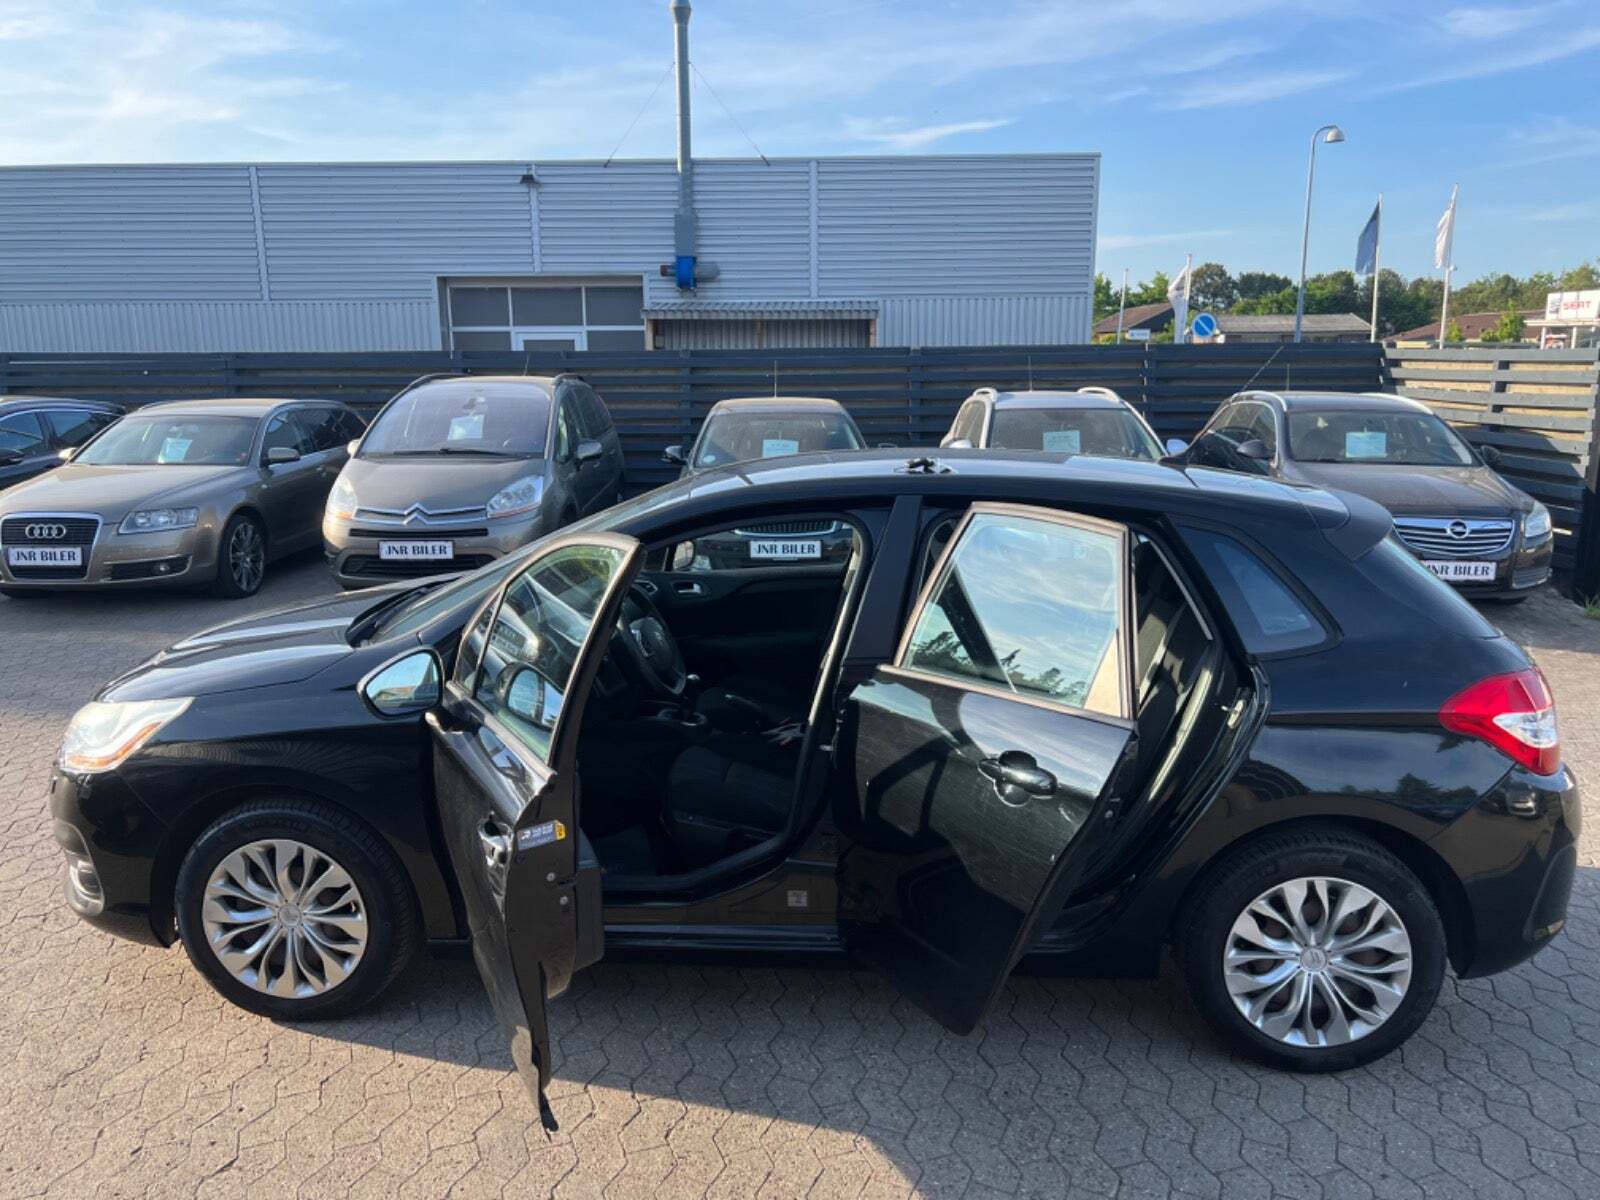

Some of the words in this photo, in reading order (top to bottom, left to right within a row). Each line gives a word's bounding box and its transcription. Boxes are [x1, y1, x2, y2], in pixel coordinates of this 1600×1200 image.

[386, 545, 408, 555] JNR
[412, 545, 447, 555] BILER
[754, 543, 777, 554] JNR
[781, 543, 816, 554] BILER
[16, 550, 37, 561] JNR
[40, 550, 76, 561] BILER
[1453, 564, 1490, 576] BILER
